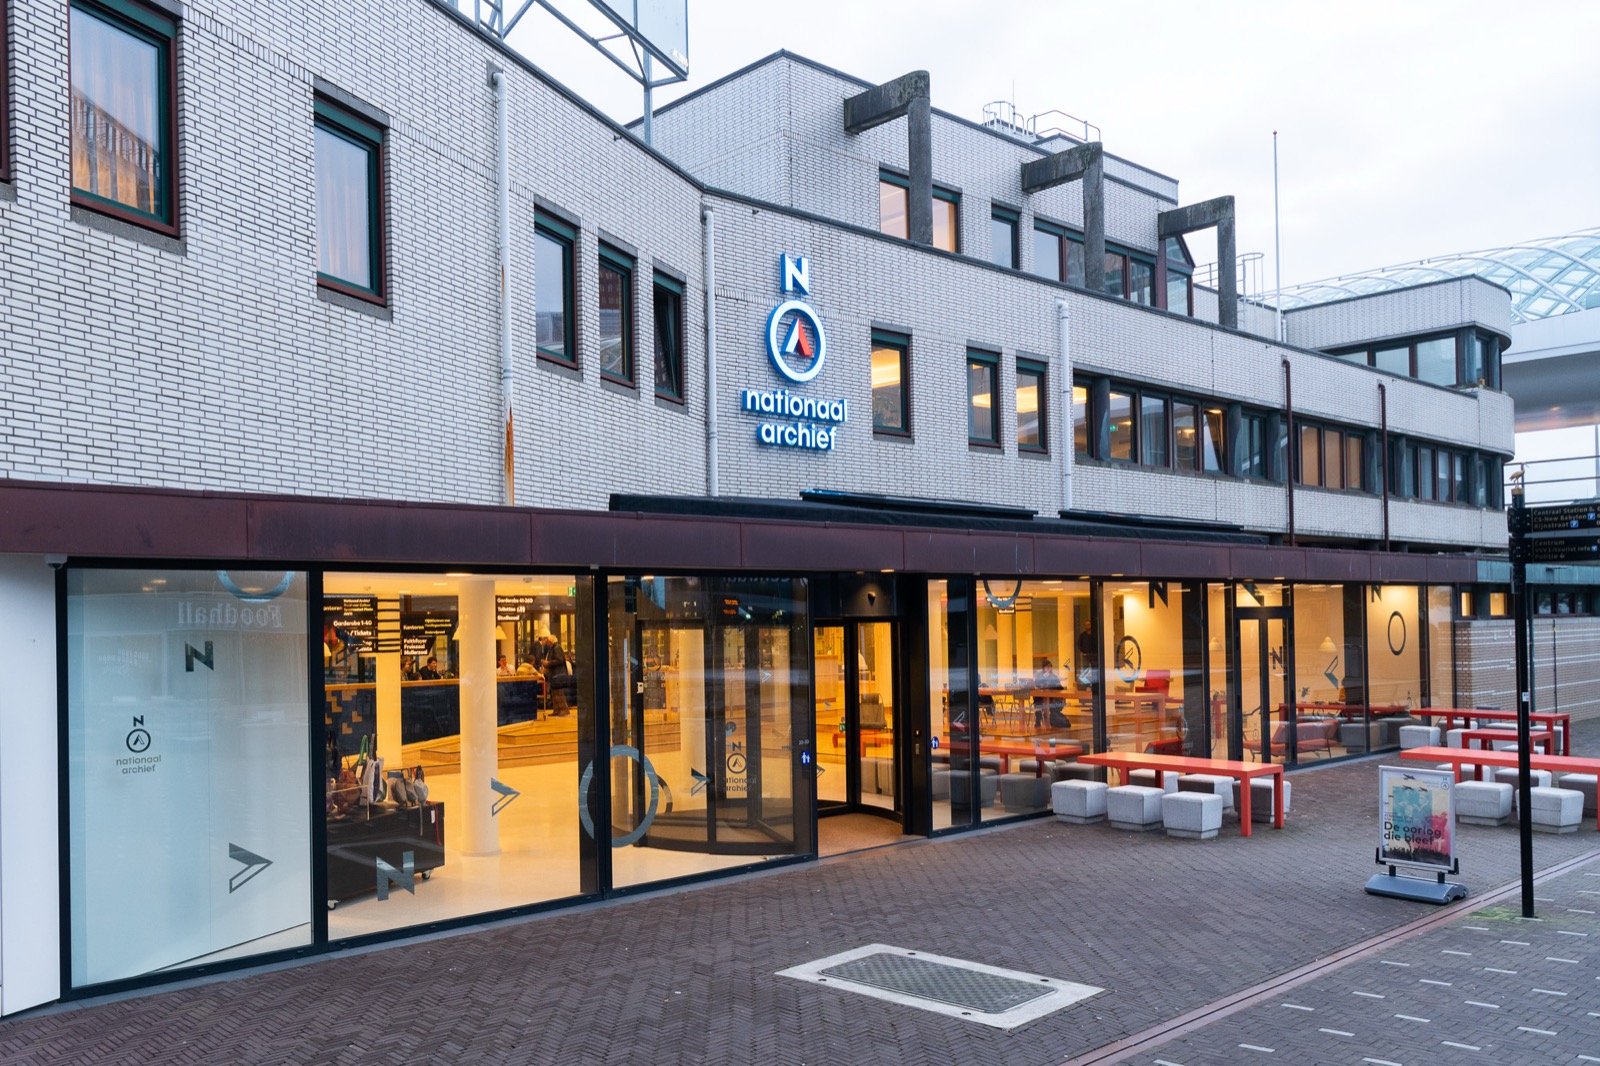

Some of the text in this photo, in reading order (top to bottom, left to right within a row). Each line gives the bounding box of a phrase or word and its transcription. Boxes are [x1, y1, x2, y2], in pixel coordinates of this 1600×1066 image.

[780, 253, 810, 296] N
[742, 390, 848, 422] nationaal
[757, 423, 837, 450] archief
[116, 754, 162, 765] nationaal
[122, 764, 155, 774] archief
[1384, 822, 1441, 838] De oorlog
[1384, 831, 1434, 844] die bleef
